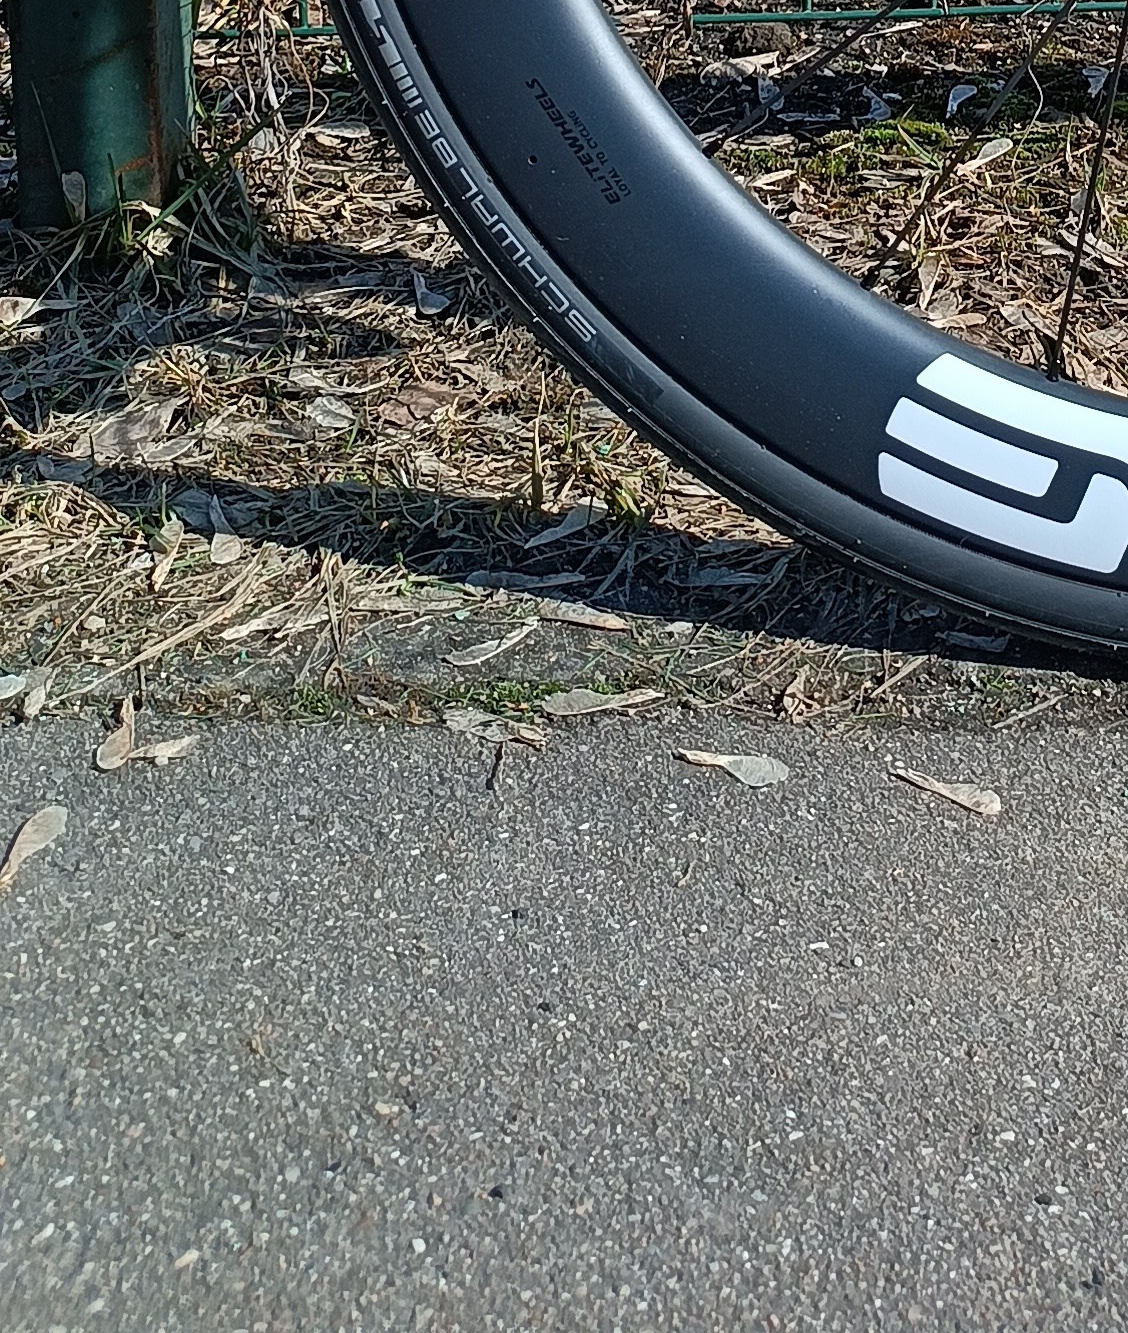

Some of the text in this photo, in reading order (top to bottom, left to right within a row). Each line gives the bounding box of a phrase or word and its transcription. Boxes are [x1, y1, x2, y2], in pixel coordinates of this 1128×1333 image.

[595, 151, 609, 166] TO
[607, 167, 632, 197] LOYAL
[414, 107, 597, 344] SCHWALBE
